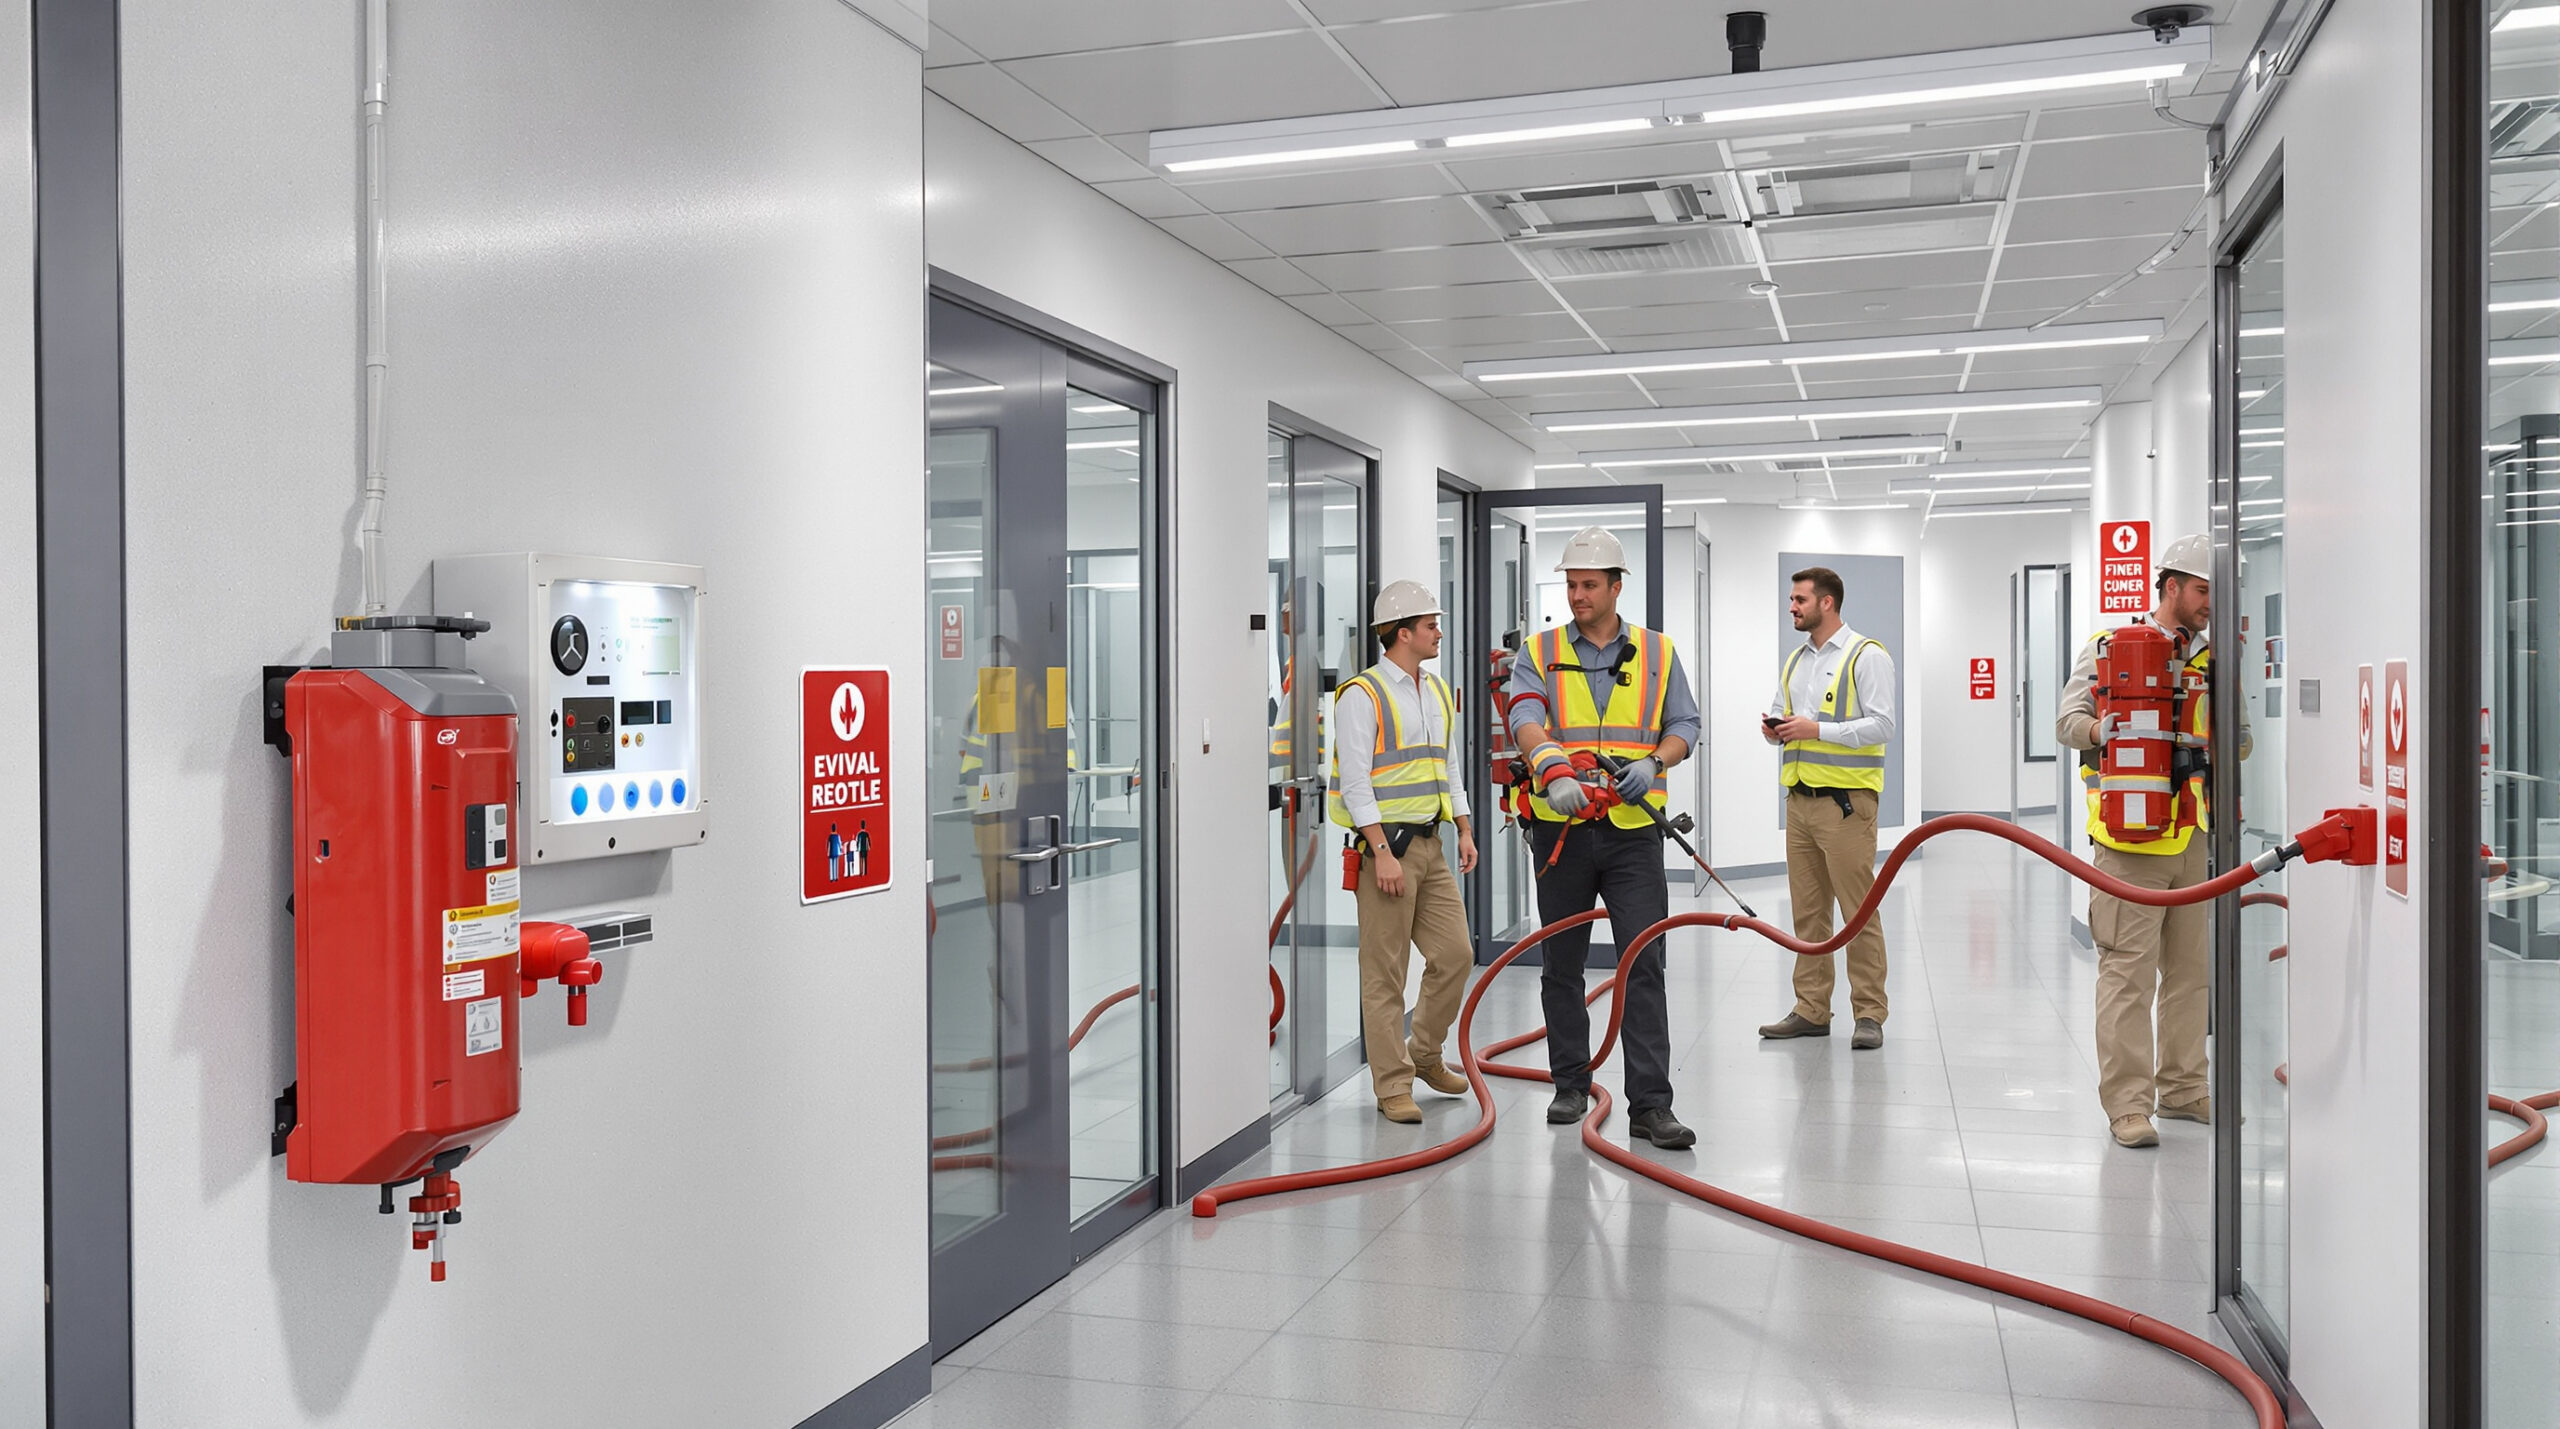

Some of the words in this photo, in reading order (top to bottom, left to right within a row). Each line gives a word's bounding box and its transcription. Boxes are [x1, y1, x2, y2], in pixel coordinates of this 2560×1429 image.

[2105, 563, 2142, 577] FINER
[814, 751, 880, 778] EVIVAL
[812, 779, 881, 807] REOTLE
